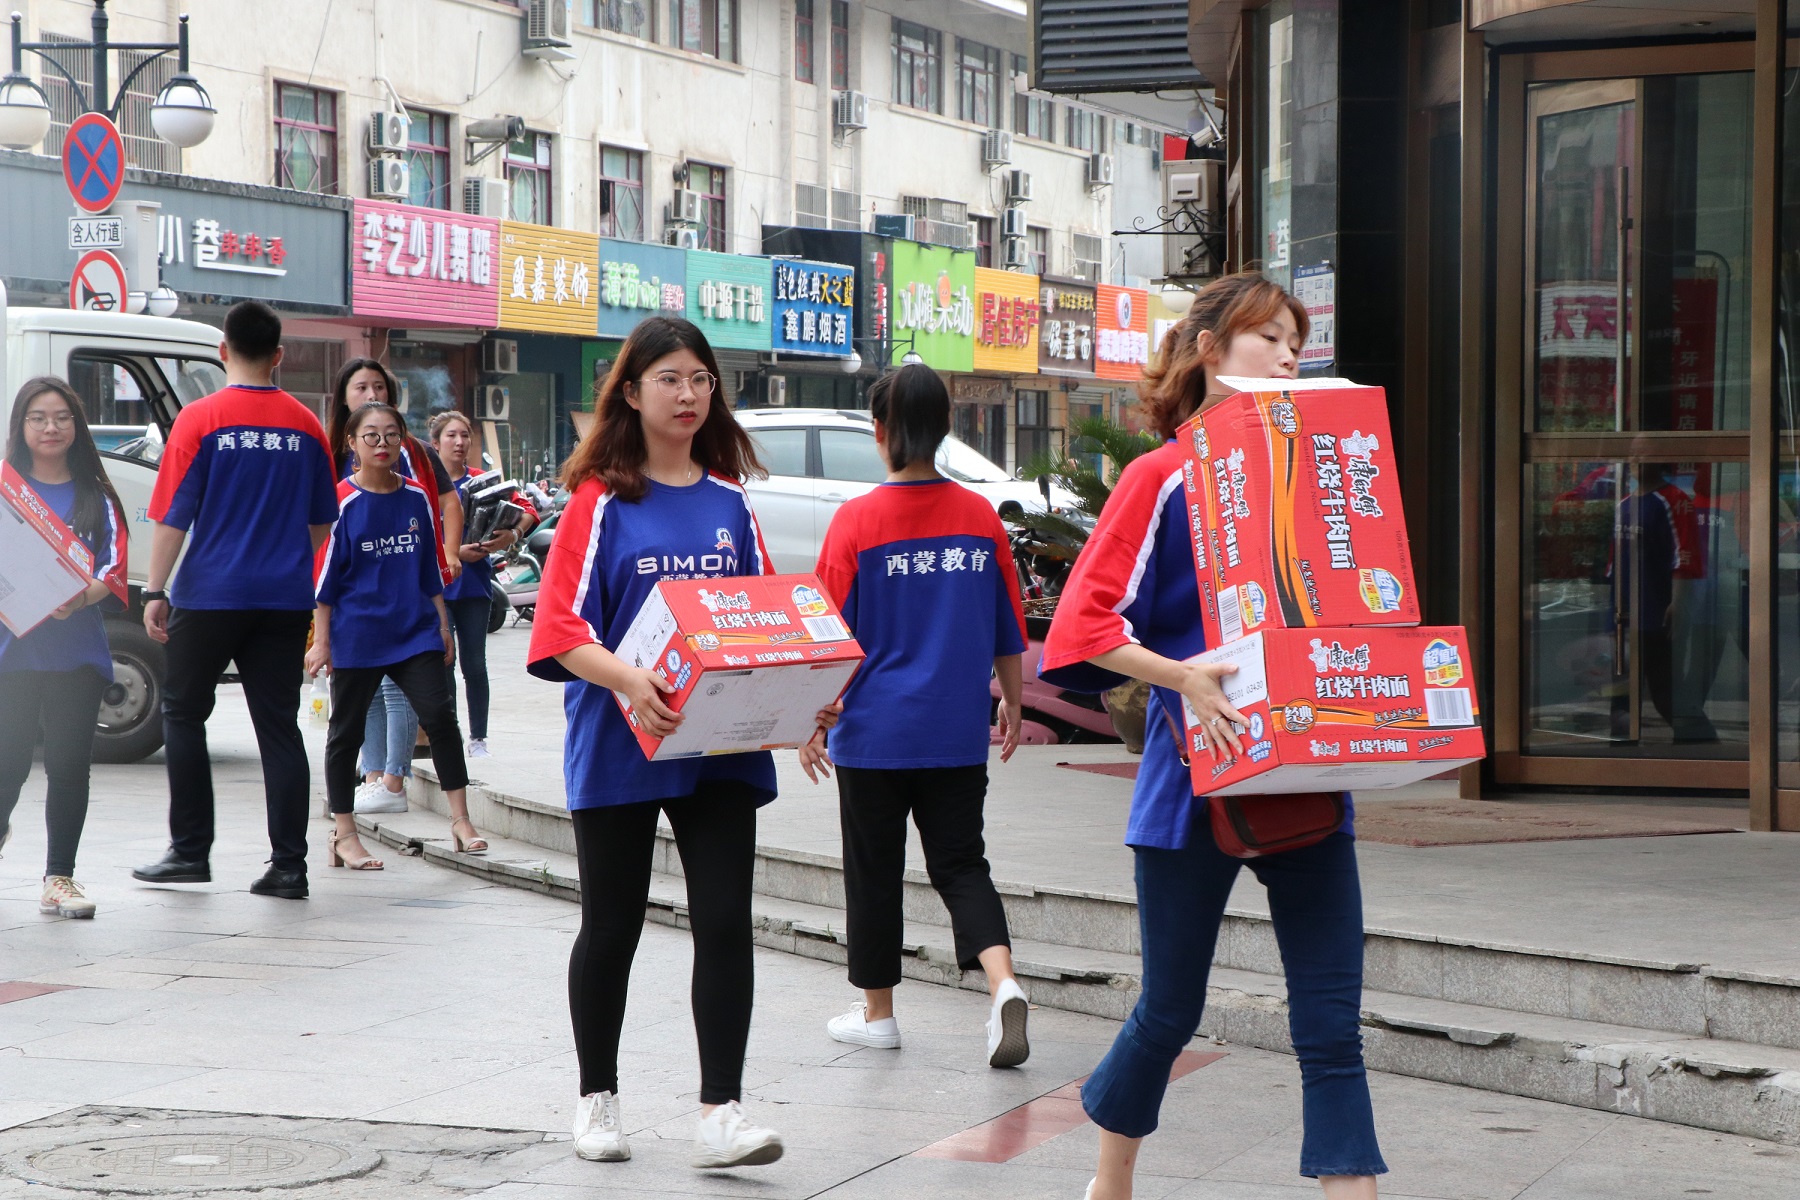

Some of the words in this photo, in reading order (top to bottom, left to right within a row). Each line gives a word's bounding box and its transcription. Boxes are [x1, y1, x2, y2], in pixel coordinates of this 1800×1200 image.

[72, 223, 120, 243] 含人行道
[221, 230, 287, 265] 串串香
[510, 255, 589, 308] 盈嘉装饰
[662, 283, 685, 311] 美妆
[700, 280, 765, 323] 中源干洗
[216, 431, 301, 452] 西蒙教育
[1311, 434, 1358, 570] 红烧牛肉面
[637, 554, 738, 575] SIMON
[885, 547, 990, 577] 西蒙教育
[711, 610, 791, 630] 红烧牛肉面
[1315, 674, 1410, 699] 红烧牛肉面
[1285, 705, 1314, 724] 经典
[1349, 738, 1409, 754] 红烧牛肉面
